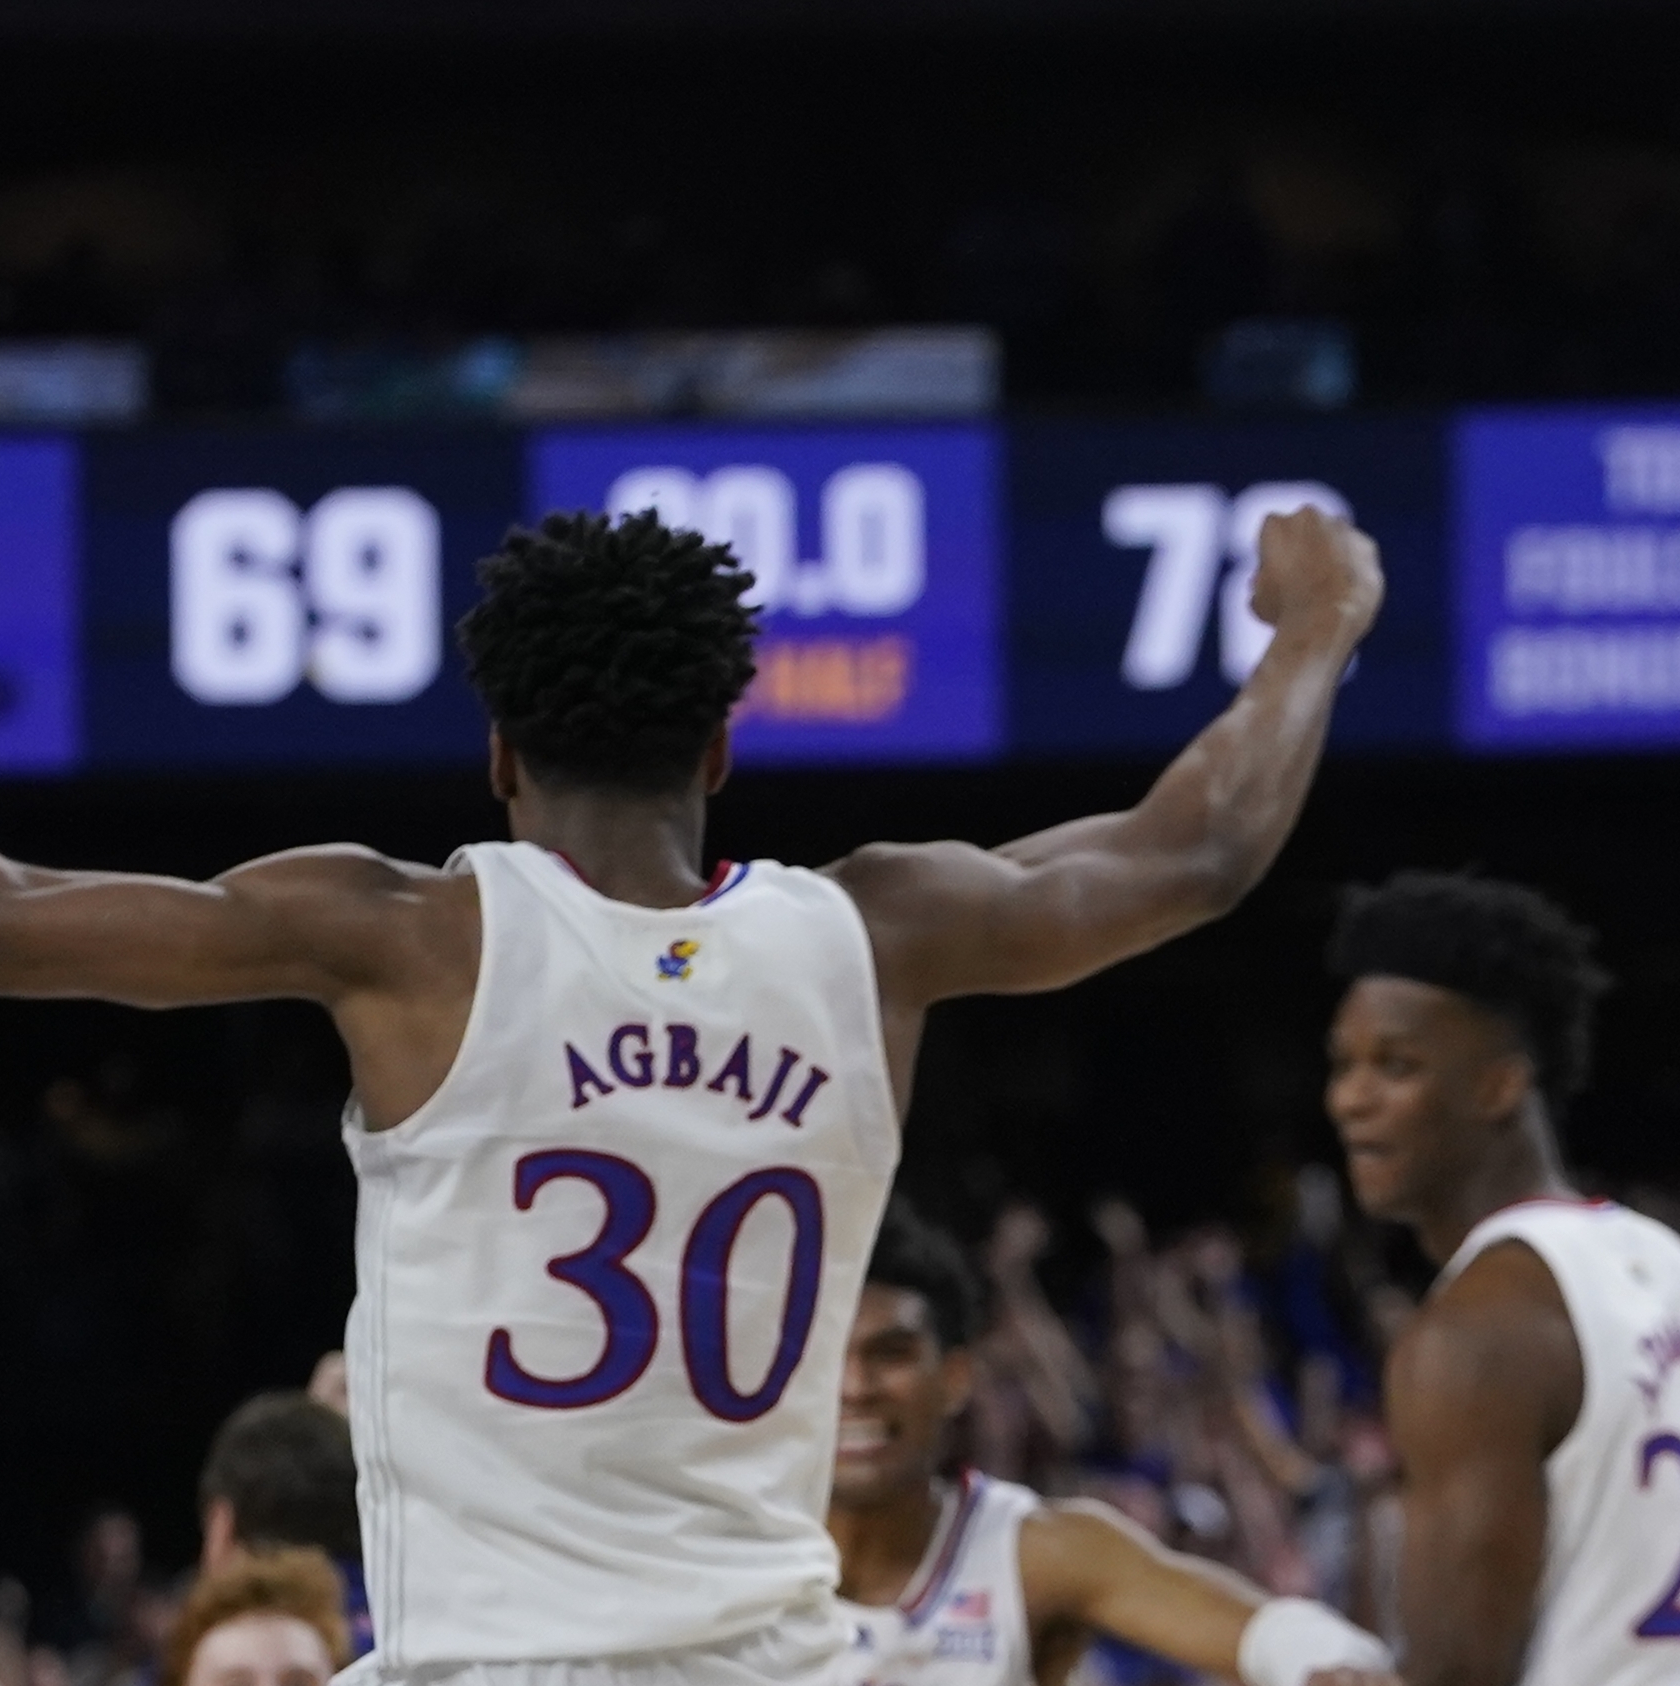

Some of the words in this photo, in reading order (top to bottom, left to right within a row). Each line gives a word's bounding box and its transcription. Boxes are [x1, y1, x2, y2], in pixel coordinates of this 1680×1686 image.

[170, 486, 441, 705] 69
[564, 1024, 831, 1128] AGBAJI
[485, 1147, 825, 1423] 30
